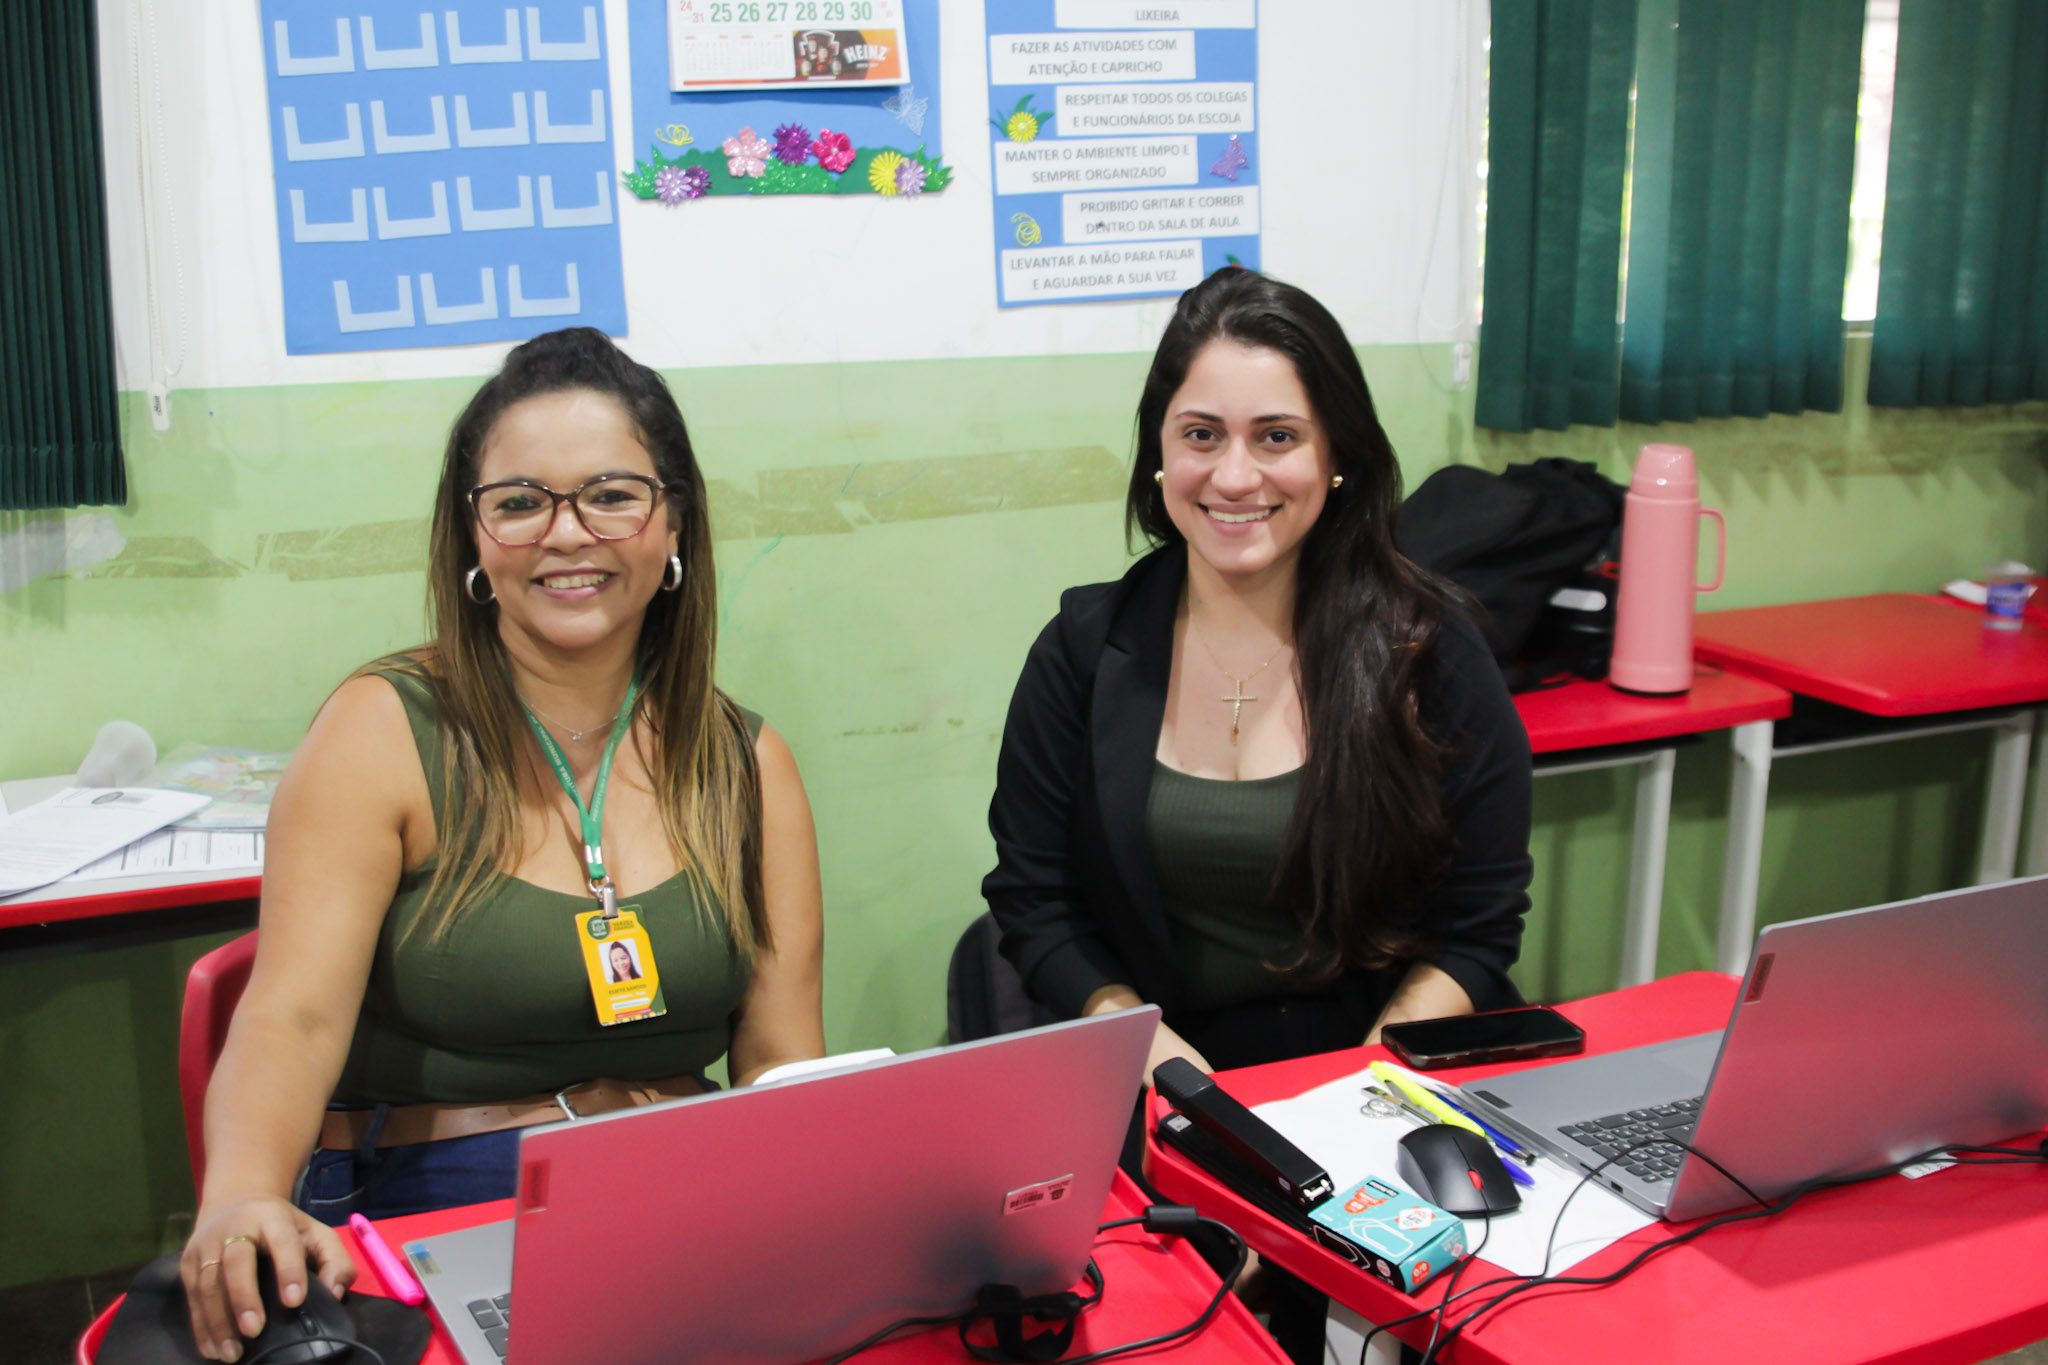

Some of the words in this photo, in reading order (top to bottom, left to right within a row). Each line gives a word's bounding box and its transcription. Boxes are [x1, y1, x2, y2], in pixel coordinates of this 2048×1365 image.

[710, 2, 732, 23] 25
[737, 2, 760, 22] 26
[767, 2, 789, 22] 27
[795, 1, 818, 21] 28
[823, 1, 845, 21] 29
[850, 1, 873, 21] 30
[1135, 9, 1180, 22] LIXEIRA
[843, 44, 889, 64] HEINZ
[1011, 41, 1050, 55] FAZER
[1053, 40, 1070, 53] AS
[1072, 39, 1145, 53] ATIVIDADES
[1147, 38, 1177, 51] COM
[1028, 60, 1088, 77] ATENÇÃO
[1091, 62, 1099, 73] E
[1101, 61, 1162, 74] CAPRICHO
[1065, 93, 1128, 106] RESPEITAR
[1132, 92, 1174, 104] TODOS
[1177, 92, 1193, 104] OS
[1196, 91, 1248, 103] COLEGAS
[1073, 115, 1081, 127] E
[1083, 112, 1175, 127] FUNCIONÁRIOS
[1178, 113, 1196, 125] DA
[1198, 112, 1241, 124] ESCOLA
[1005, 149, 1060, 162] MANTER
[1064, 148, 1072, 160] O
[1076, 146, 1139, 160] AMBIENTE
[1142, 145, 1180, 157] LIMPO
[1182, 144, 1190, 156] E
[1032, 169, 1082, 183] SEMPRE
[1084, 166, 1166, 181] ORGANIZADO
[1080, 199, 1139, 213] PROIBIDO
[1142, 197, 1186, 210] GRITAR
[1188, 196, 1196, 208] E
[1198, 195, 1244, 208] CORRER
[1086, 220, 1135, 235] DENTRO
[1138, 219, 1155, 232] DA
[1158, 218, 1187, 231] SALA
[1190, 217, 1205, 229] DE
[1208, 216, 1240, 228] AULA
[1010, 256, 1074, 270] LEVANTAR
[1078, 254, 1087, 265] A
[1091, 250, 1121, 265] MÃO
[1124, 250, 1156, 263] PARA
[1159, 248, 1195, 261] FALAR
[1033, 278, 1040, 290] E
[1043, 275, 1114, 289] AGUARDAR
[1117, 274, 1125, 285] A
[1128, 271, 1152, 283] SUA
[1155, 270, 1177, 282] VEZ
